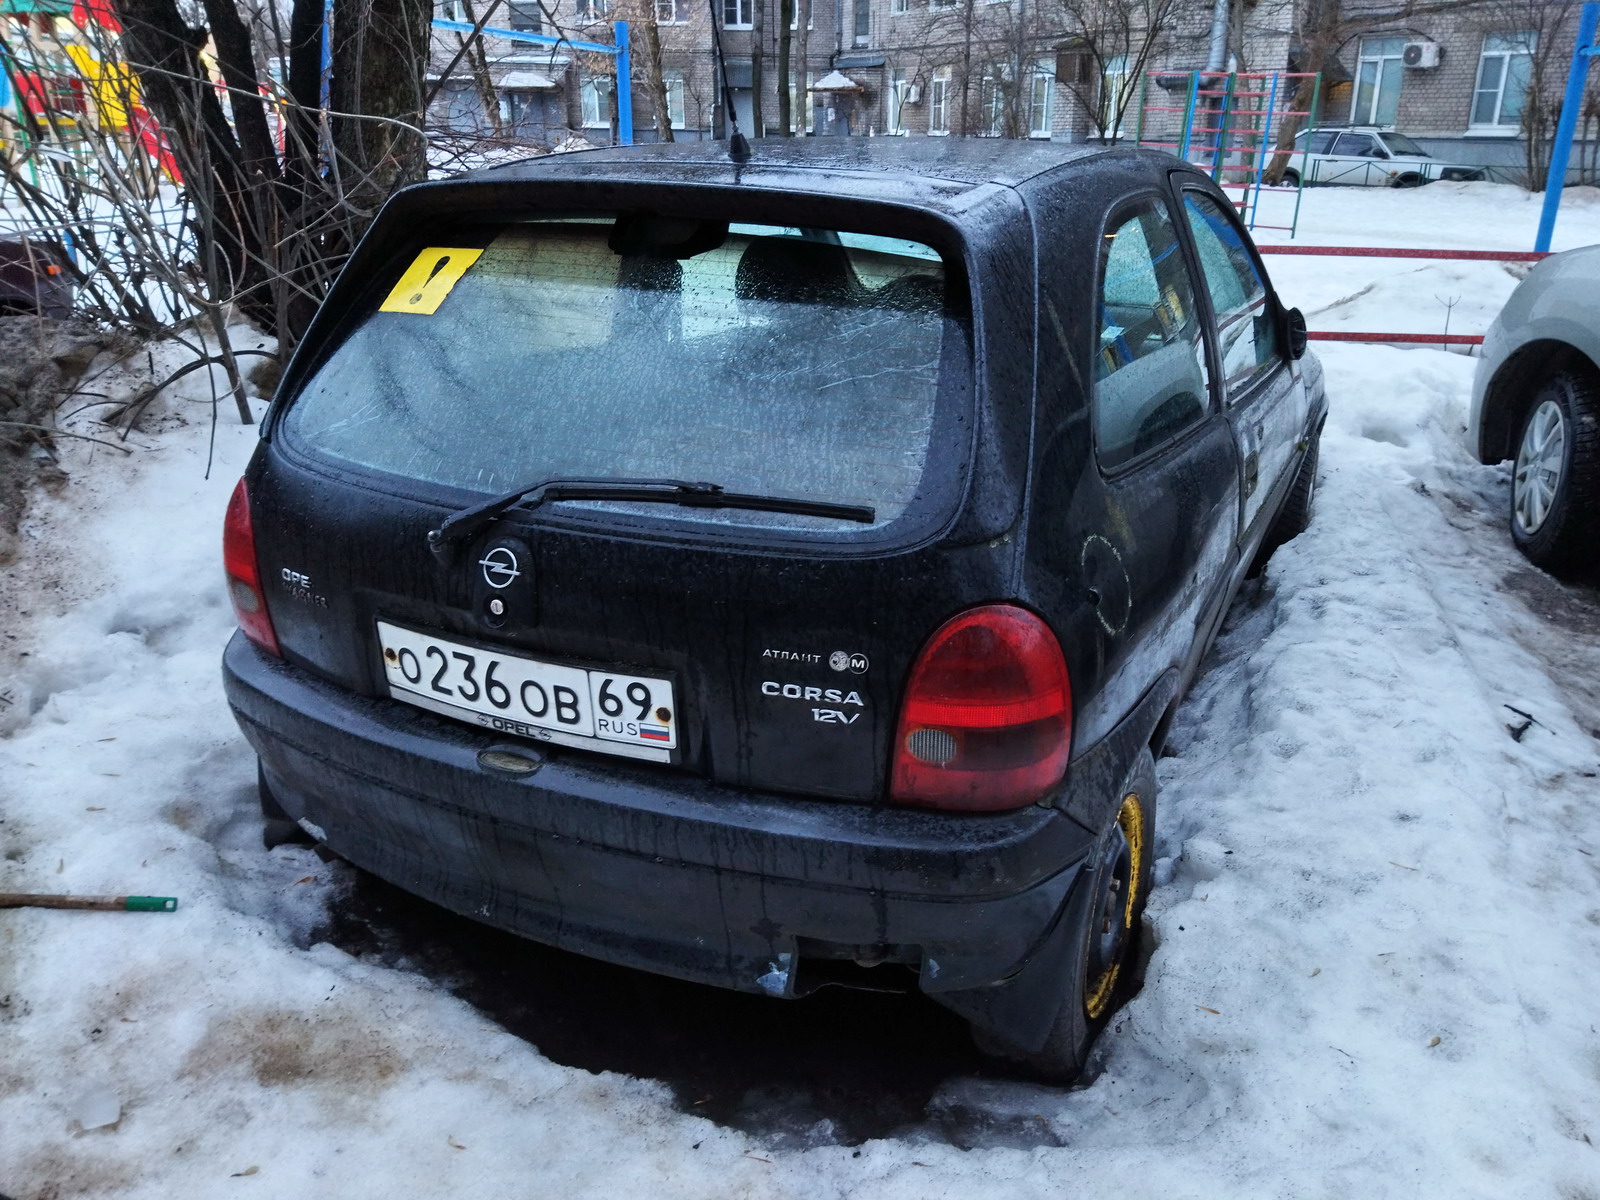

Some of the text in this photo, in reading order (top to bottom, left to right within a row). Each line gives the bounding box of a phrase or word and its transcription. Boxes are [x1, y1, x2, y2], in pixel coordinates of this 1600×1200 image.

[599, 678, 653, 721] 69
[761, 681, 864, 706] CORSA
[811, 708, 860, 724] 12V
[492, 718, 536, 737] OPEL
[598, 718, 638, 736] RUS
